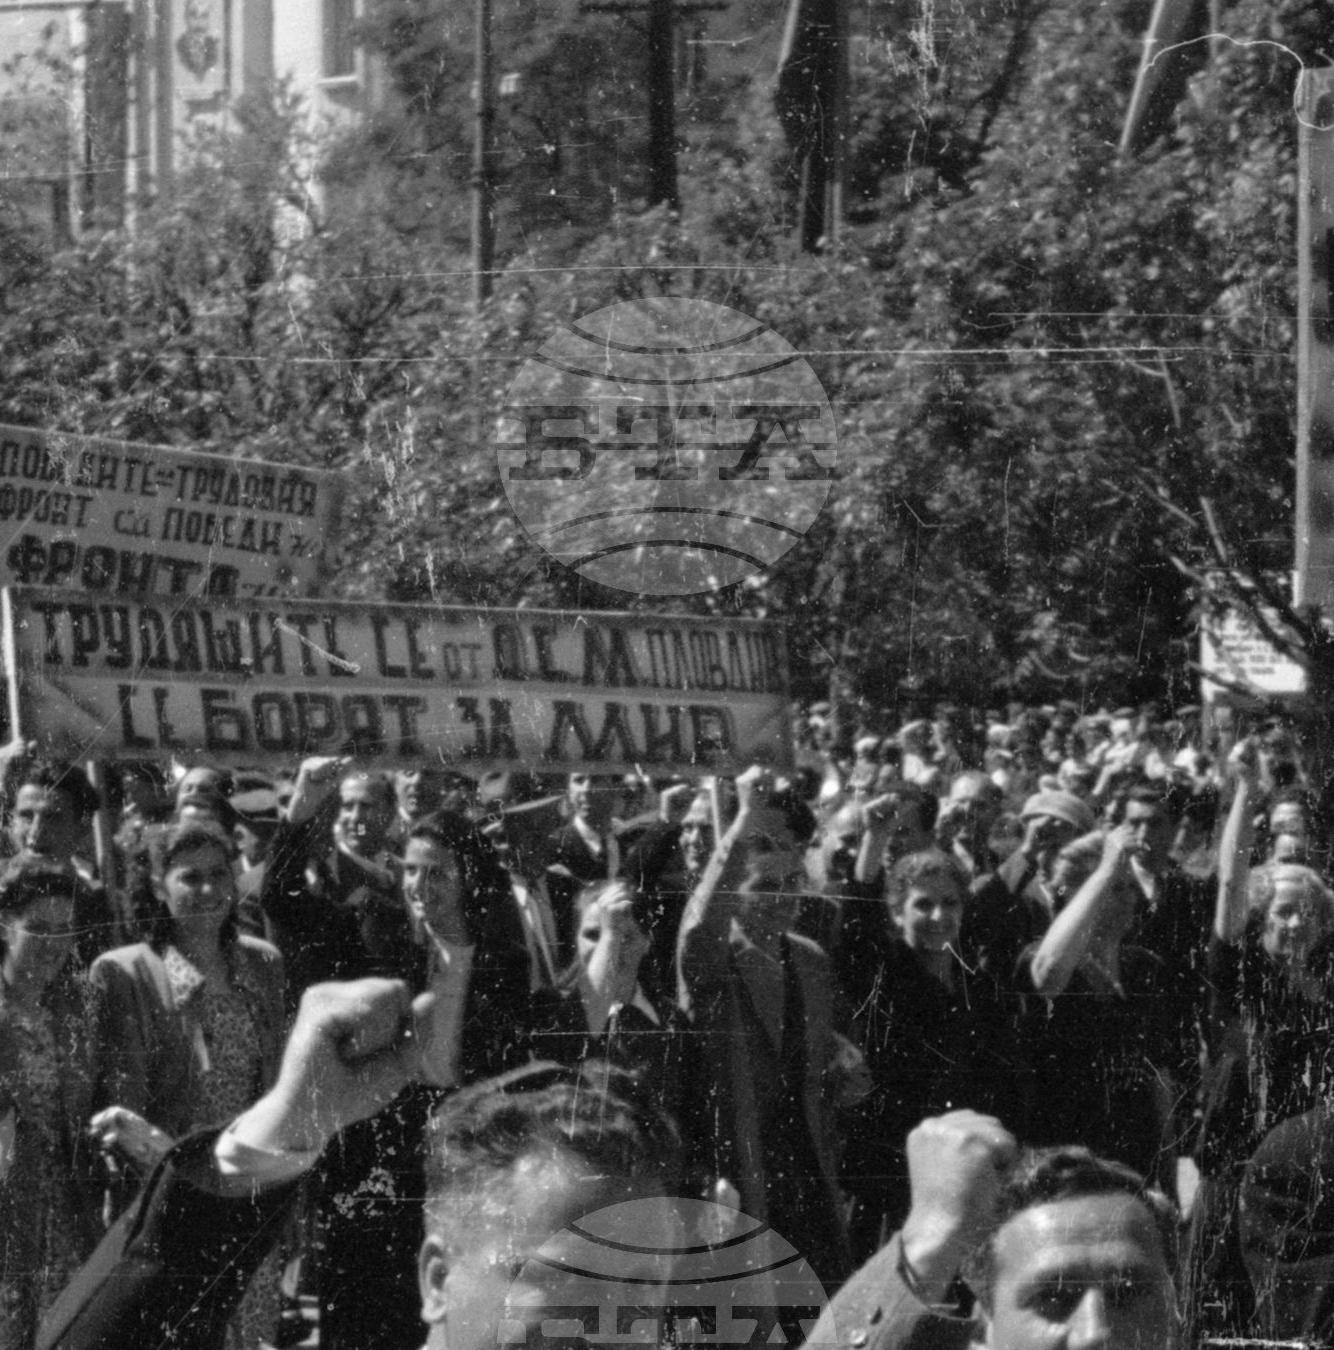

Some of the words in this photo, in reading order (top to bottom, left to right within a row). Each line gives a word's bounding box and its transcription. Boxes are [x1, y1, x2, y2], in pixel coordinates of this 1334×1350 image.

[370, 613, 435, 680] СЕ
[118, 684, 187, 751] СЕ
[200, 688, 429, 757] БОРЯТ
[457, 697, 517, 753] ЗА
[549, 701, 735, 762] МИР
